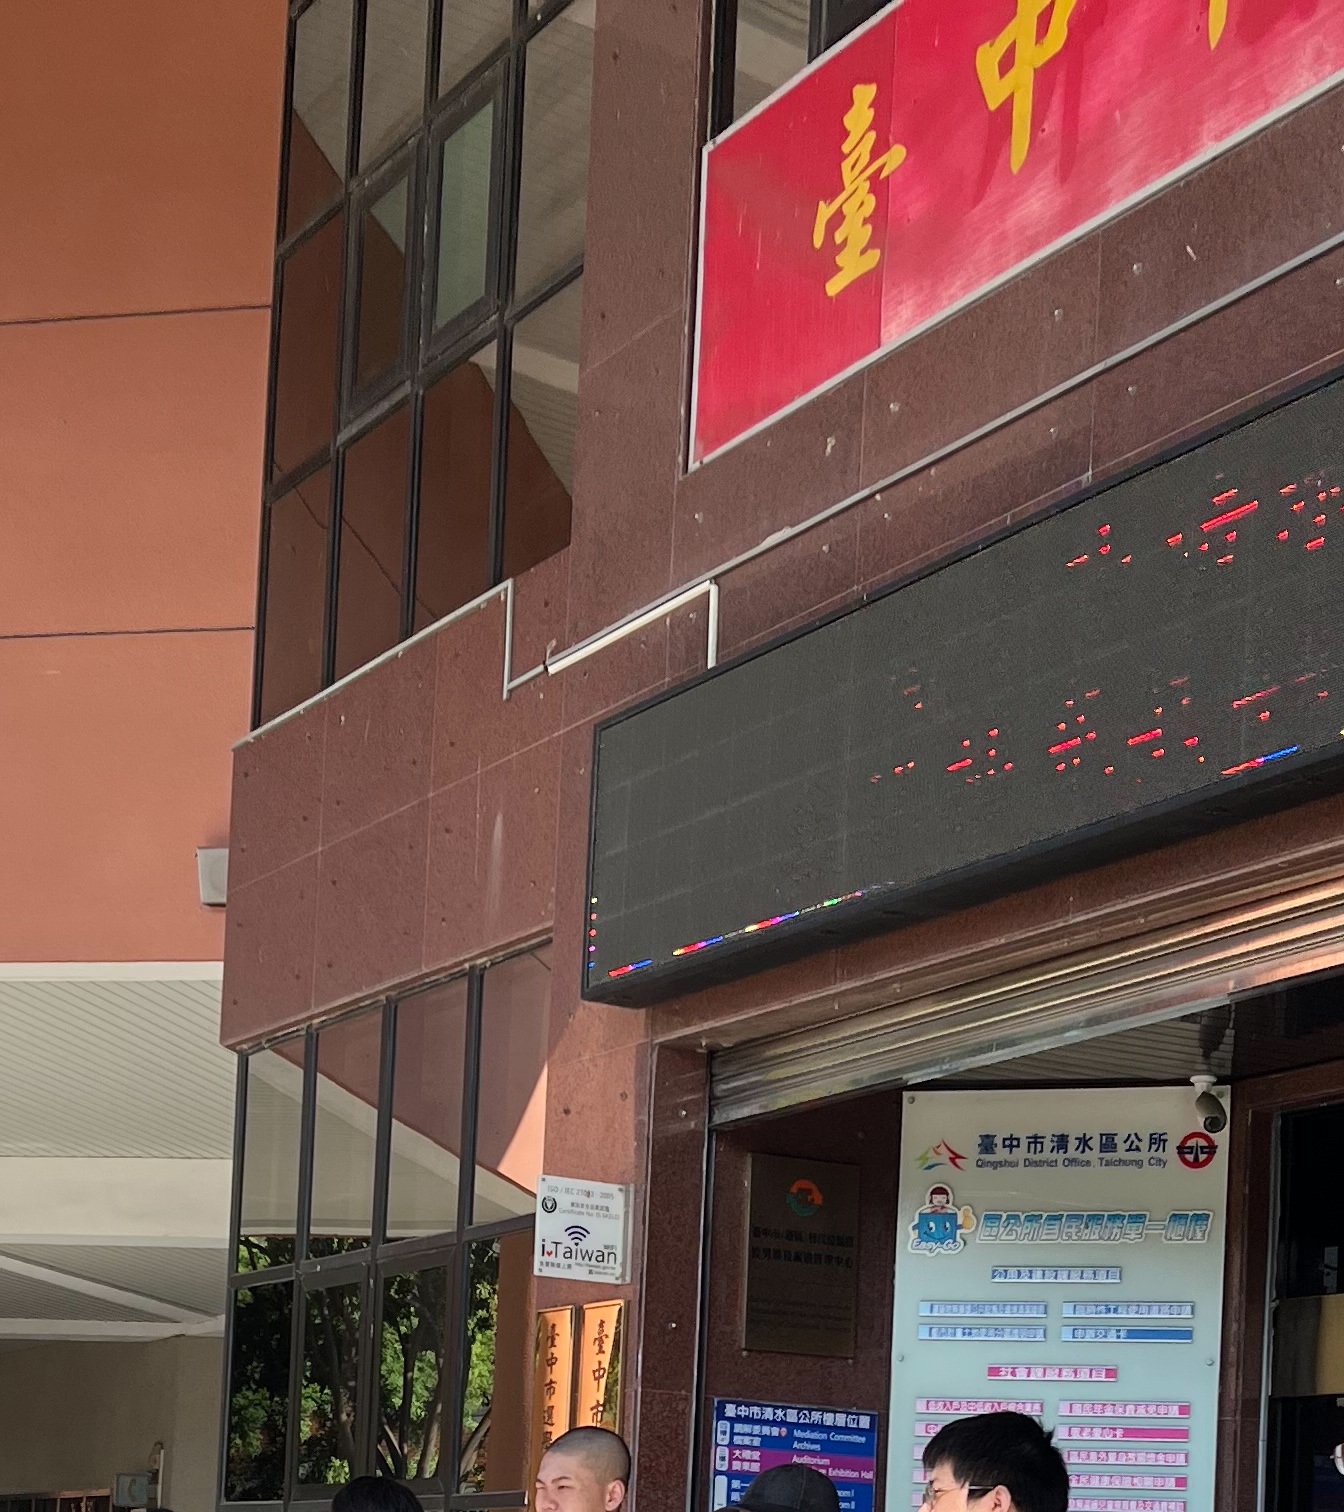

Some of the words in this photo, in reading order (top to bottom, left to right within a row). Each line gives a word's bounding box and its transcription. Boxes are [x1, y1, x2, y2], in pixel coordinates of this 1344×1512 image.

[812, 0, 1229, 297] 臺中
[977, 1132, 1169, 1156] 臺中市清水區公所
[975, 1157, 1020, 1171] Qingshui
[1024, 1157, 1058, 1169] District
[1098, 1157, 1144, 1171] Taichung
[1147, 1157, 1168, 1170] City
[564, 1187, 575, 1196] IEC
[910, 1238, 960, 1253] Easy-Go
[793, 1428, 828, 1441] Mediation
[829, 1431, 866, 1444] Committee
[792, 1440, 821, 1452] Archives
[791, 1454, 831, 1465] Auditorium
[828, 1468, 859, 1479] Exhibition
[861, 1470, 874, 1480] Hall
